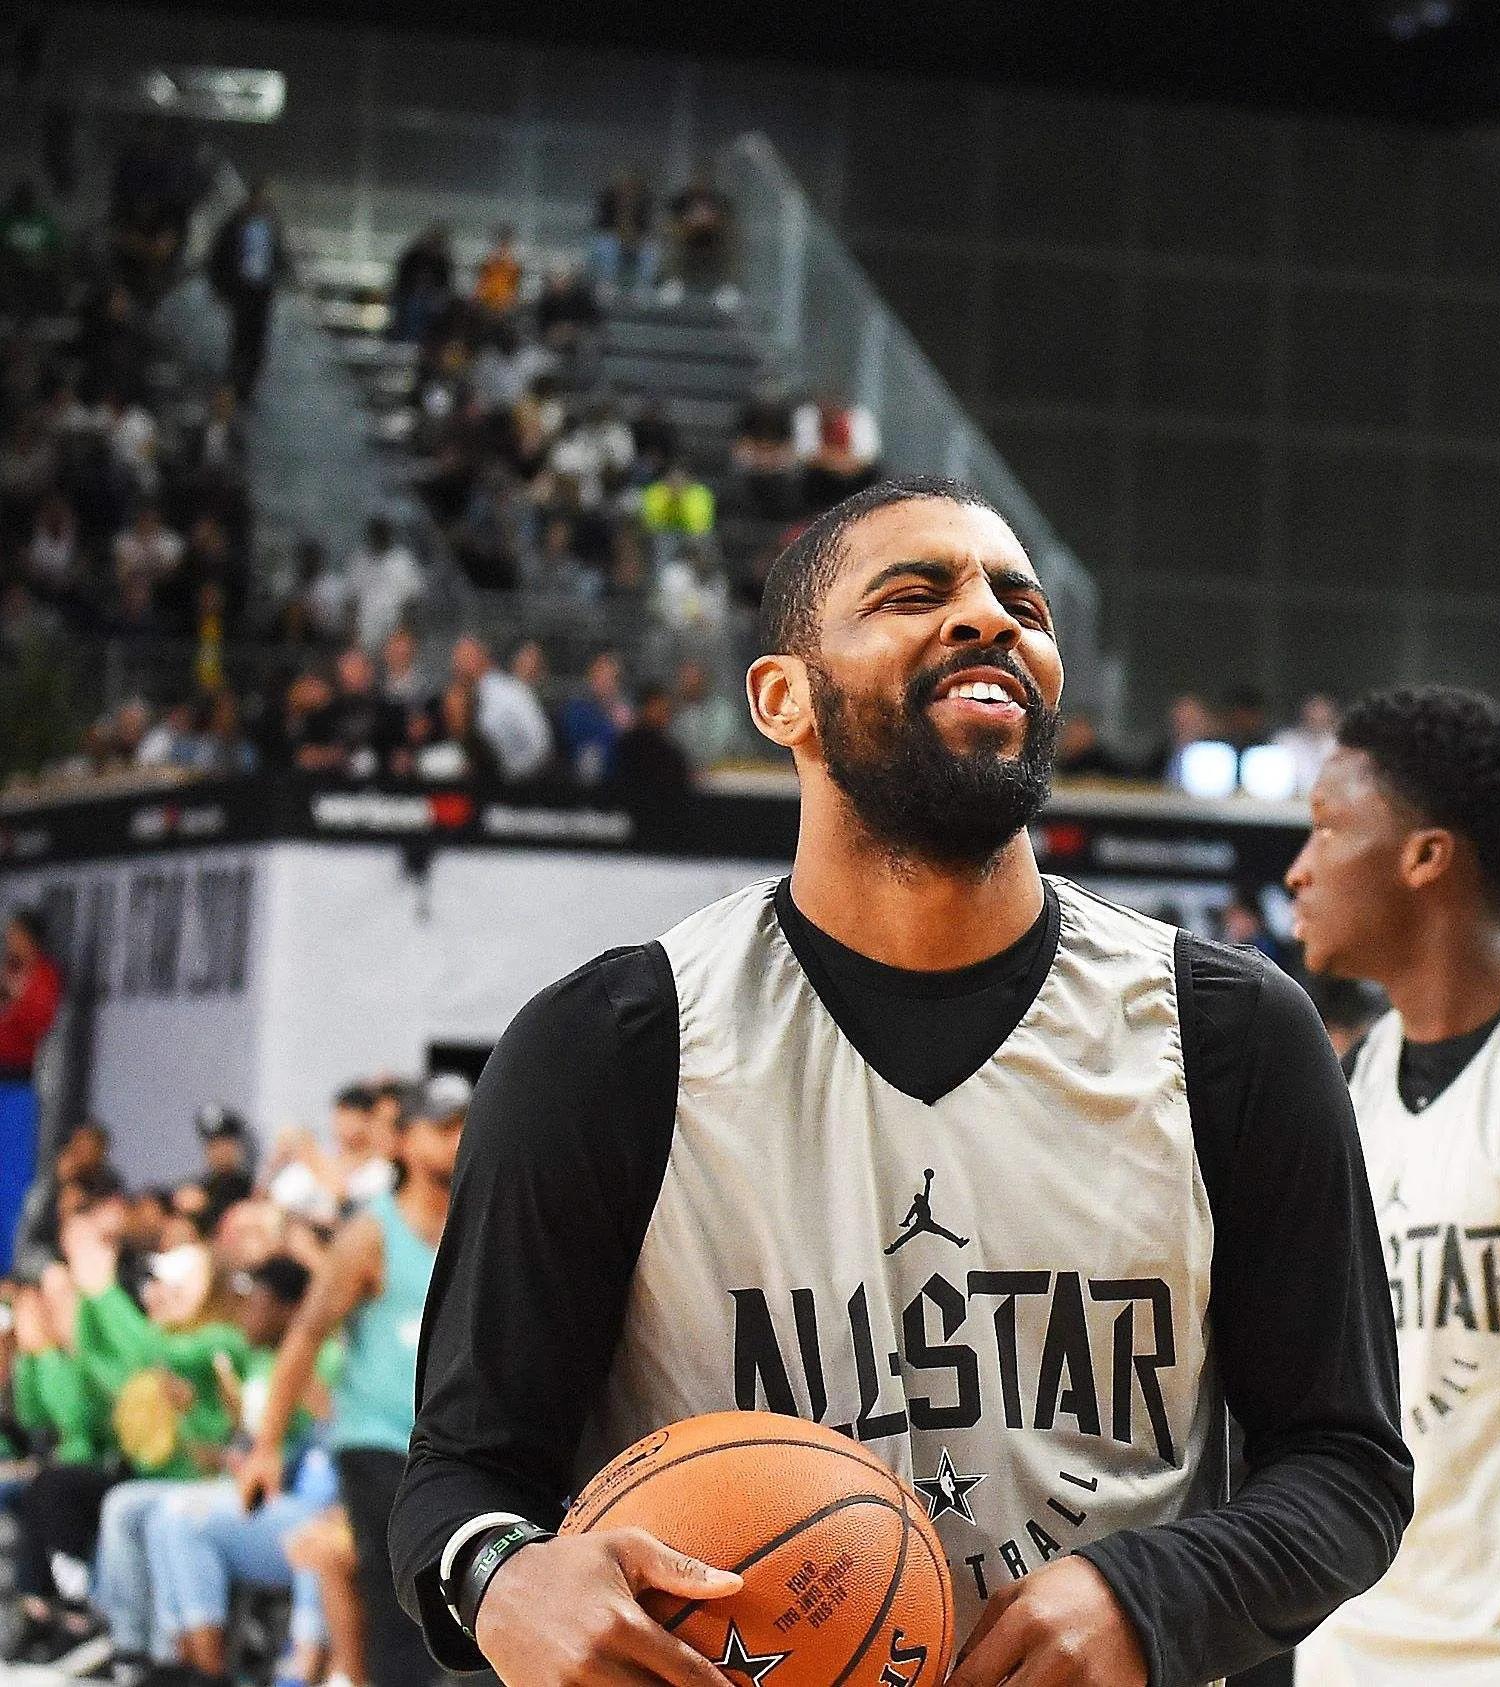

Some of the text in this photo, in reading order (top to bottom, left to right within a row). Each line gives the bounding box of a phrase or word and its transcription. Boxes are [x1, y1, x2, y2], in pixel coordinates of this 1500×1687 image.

[727, 1270, 1182, 1468] ALL-STAR
[473, 1528, 524, 1577] REAL
[786, 1560, 818, 1594] @NBA
[797, 1587, 824, 1615] GAME
[773, 1606, 799, 1633] BALL
